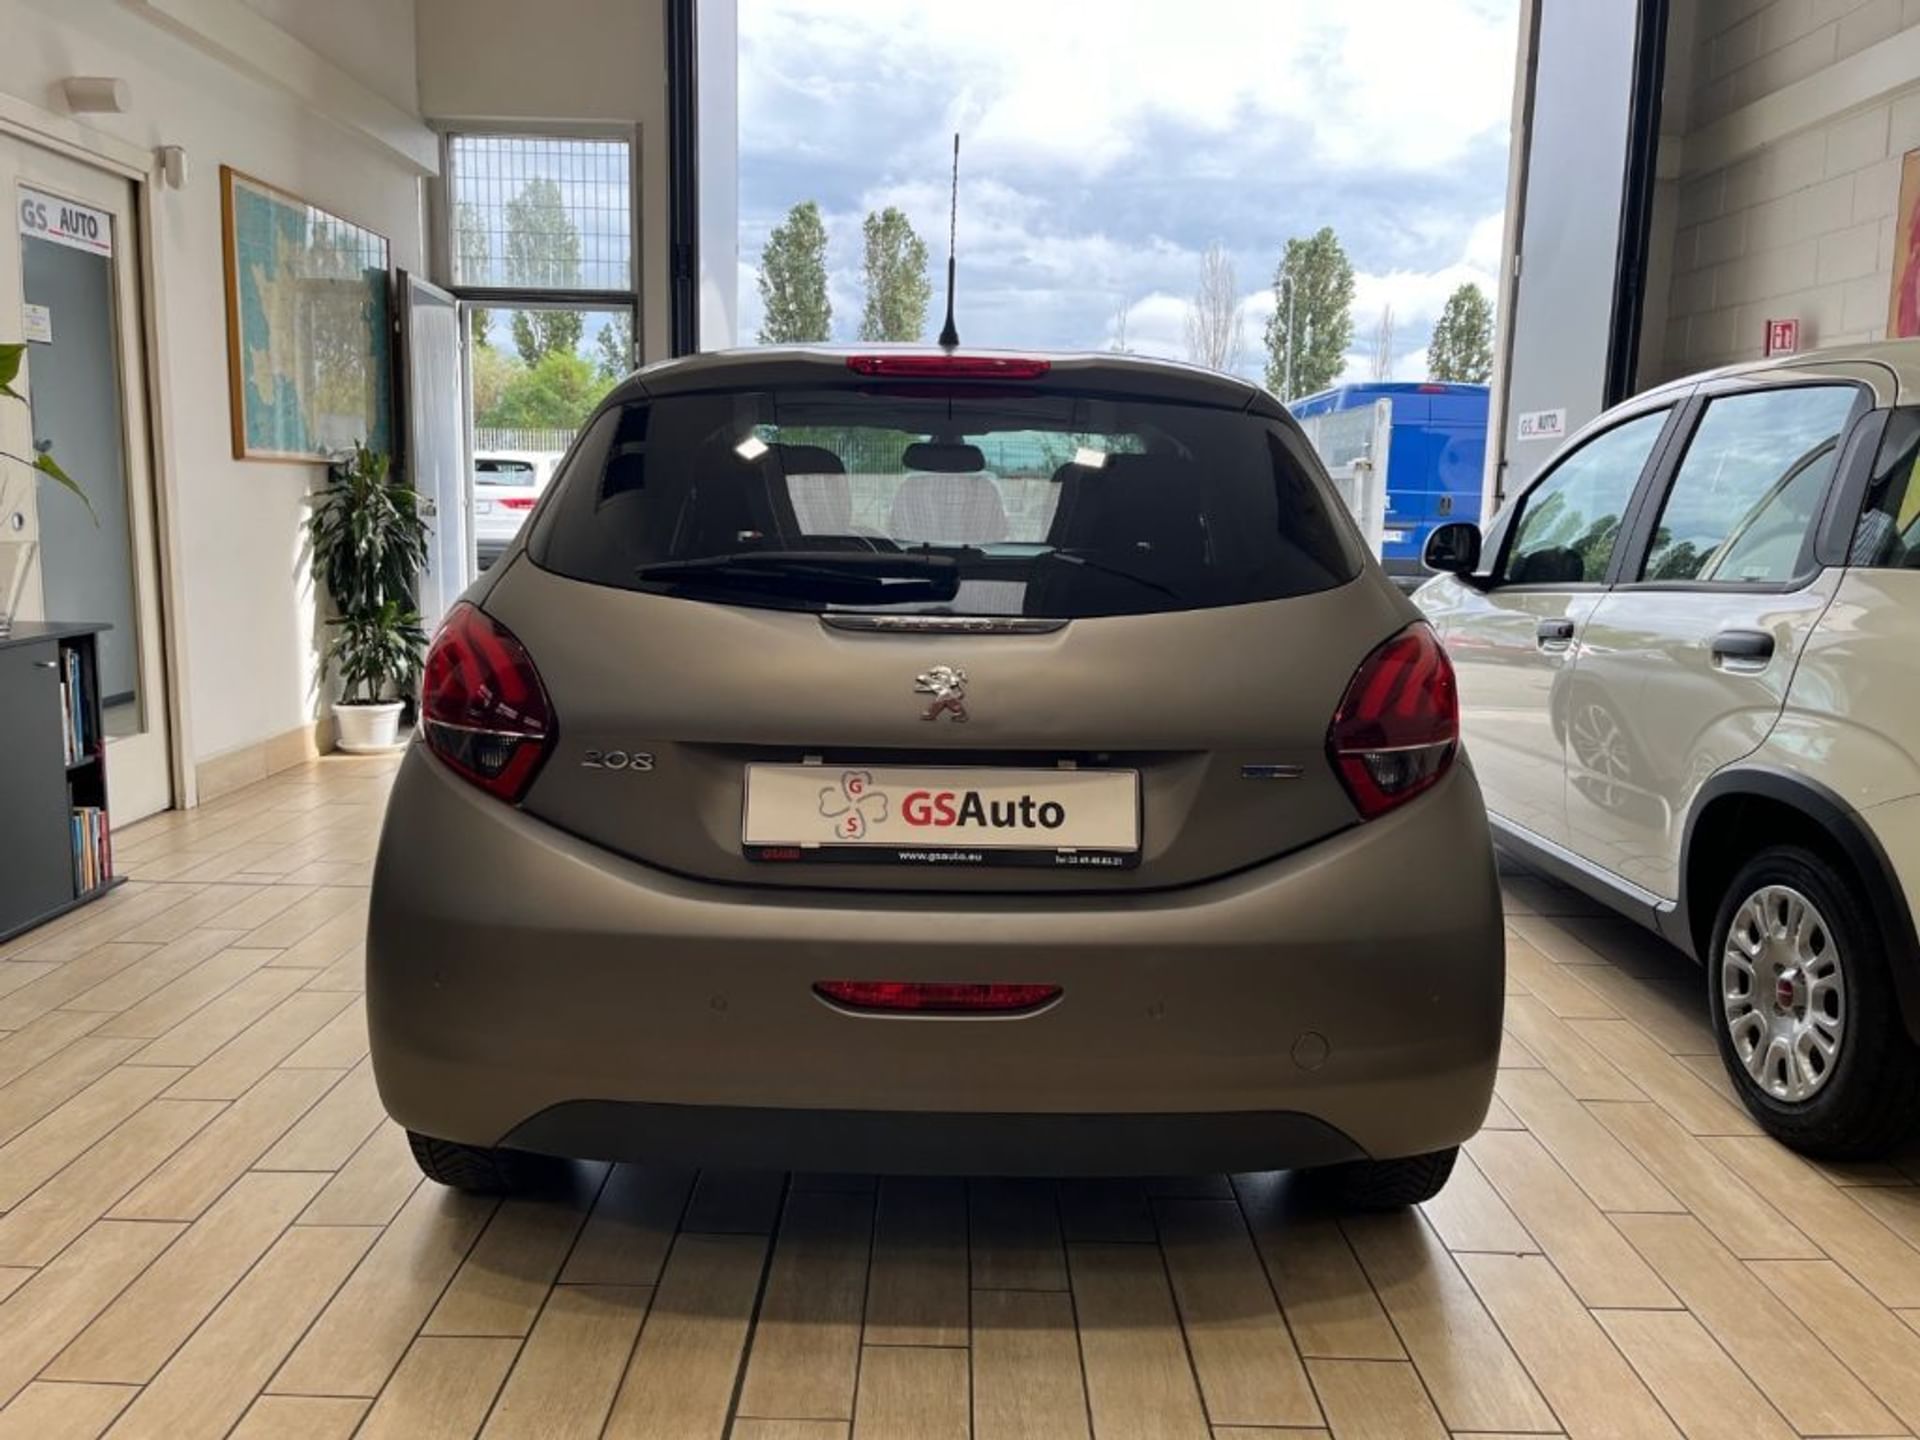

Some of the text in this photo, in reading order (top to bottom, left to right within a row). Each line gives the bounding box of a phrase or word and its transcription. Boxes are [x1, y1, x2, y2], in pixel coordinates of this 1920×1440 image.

[21, 198, 99, 239] GS AUTO
[581, 750, 654, 771] 208
[849, 778, 862, 794] G
[902, 791, 1065, 828] GSAuto
[847, 817, 858, 832] S
[899, 851, 982, 862] www.gsauto.eu
